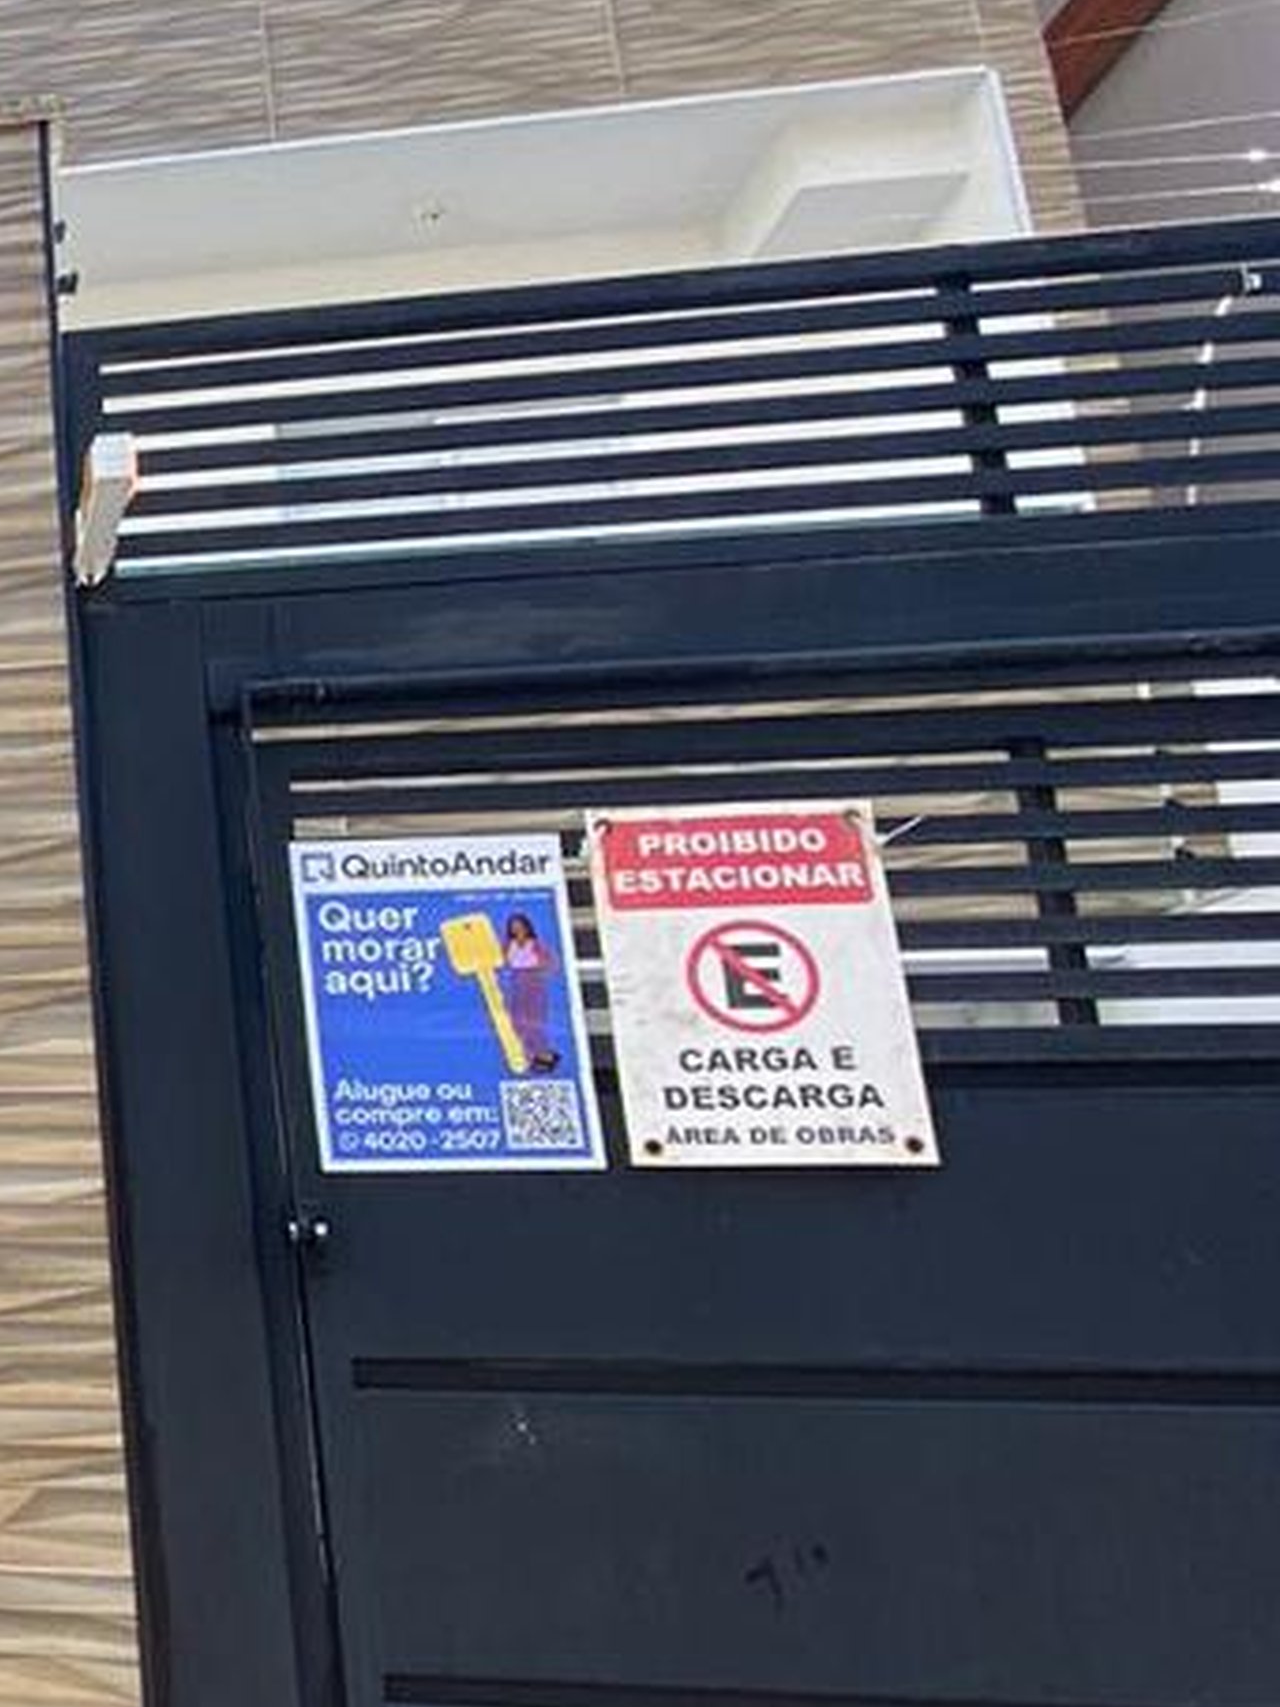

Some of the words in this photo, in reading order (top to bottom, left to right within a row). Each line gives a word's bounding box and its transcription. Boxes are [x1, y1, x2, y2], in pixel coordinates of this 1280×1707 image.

[639, 827, 827, 856] PROIBIDO
[340, 849, 550, 880] QuintoAndar
[615, 862, 866, 892] ESTACIONAR
[318, 901, 418, 934] Quer
[322, 939, 440, 963] morar
[325, 963, 434, 1000] aqui?
[679, 1047, 818, 1074] CARGA
[831, 1046, 857, 1071] E
[337, 1078, 430, 1106] Alugue
[436, 1081, 472, 1100] ou
[662, 1083, 885, 1111] DESCARGA
[335, 1106, 443, 1132] compre
[749, 1126, 788, 1144] DE
[795, 1126, 895, 1144] OBRAS
